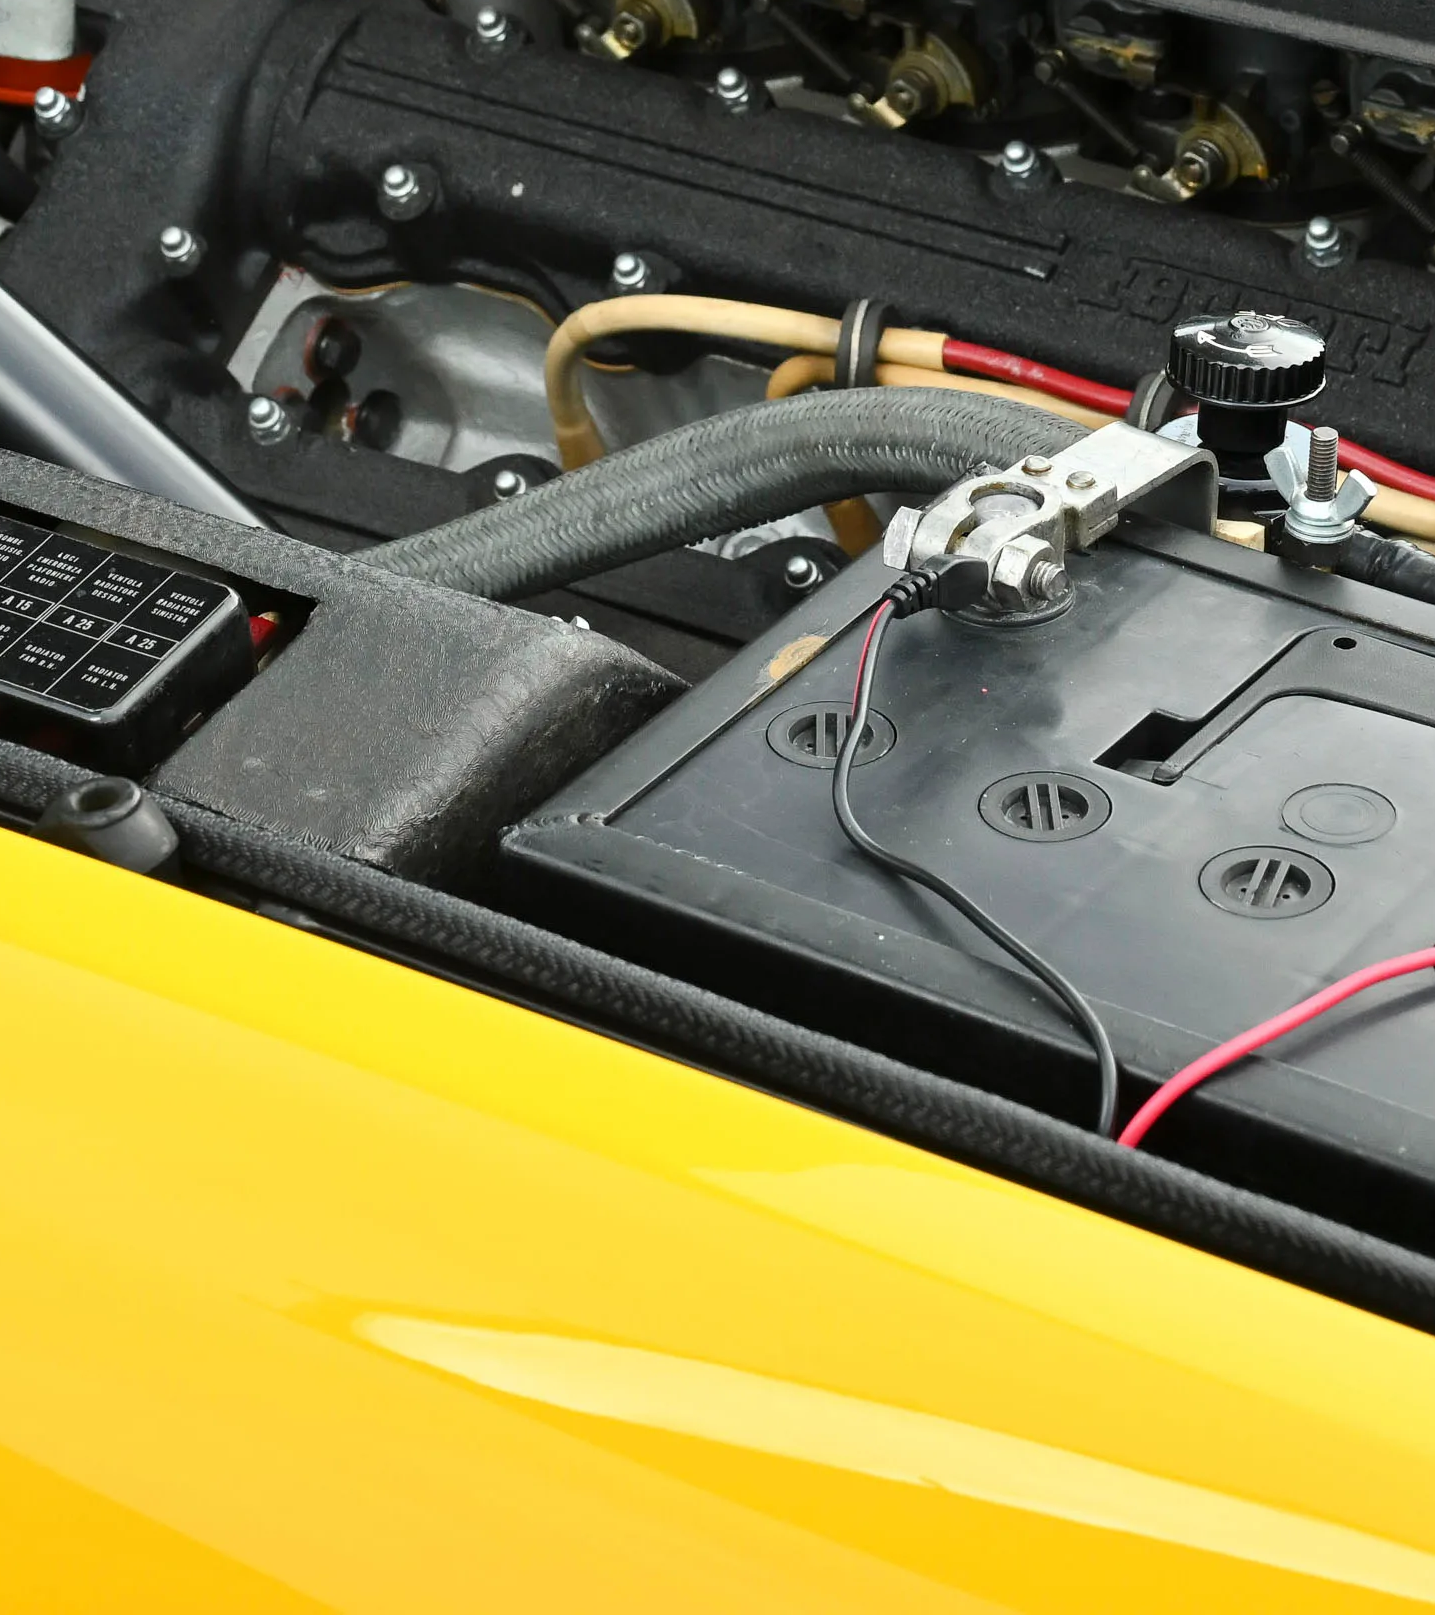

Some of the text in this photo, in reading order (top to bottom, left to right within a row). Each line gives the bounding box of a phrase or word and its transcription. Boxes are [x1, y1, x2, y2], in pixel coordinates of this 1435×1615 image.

[36, 556, 81, 573] EMERGENZA
[57, 552, 79, 562] LUCI
[26, 563, 75, 581] PLAFONIERE
[28, 574, 55, 586] RADIO
[107, 573, 142, 587] VENTOLA
[91, 589, 122, 603] DESTRA
[93, 579, 138, 597] RADIATORE
[1, 595, 33, 610] A 15
[155, 598, 199, 615] RADIATORE
[170, 592, 204, 606] VENTOLA
[62, 614, 94, 630] A 25
[151, 608, 187, 623] SINISTRA
[124, 634, 156, 649] A 25
[25, 644, 65, 661] RADIATOR
[19, 653, 58, 669] FAN R.H.
[87, 665, 128, 681] RADIATOR
[81, 673, 118, 690] FAN L.H.
